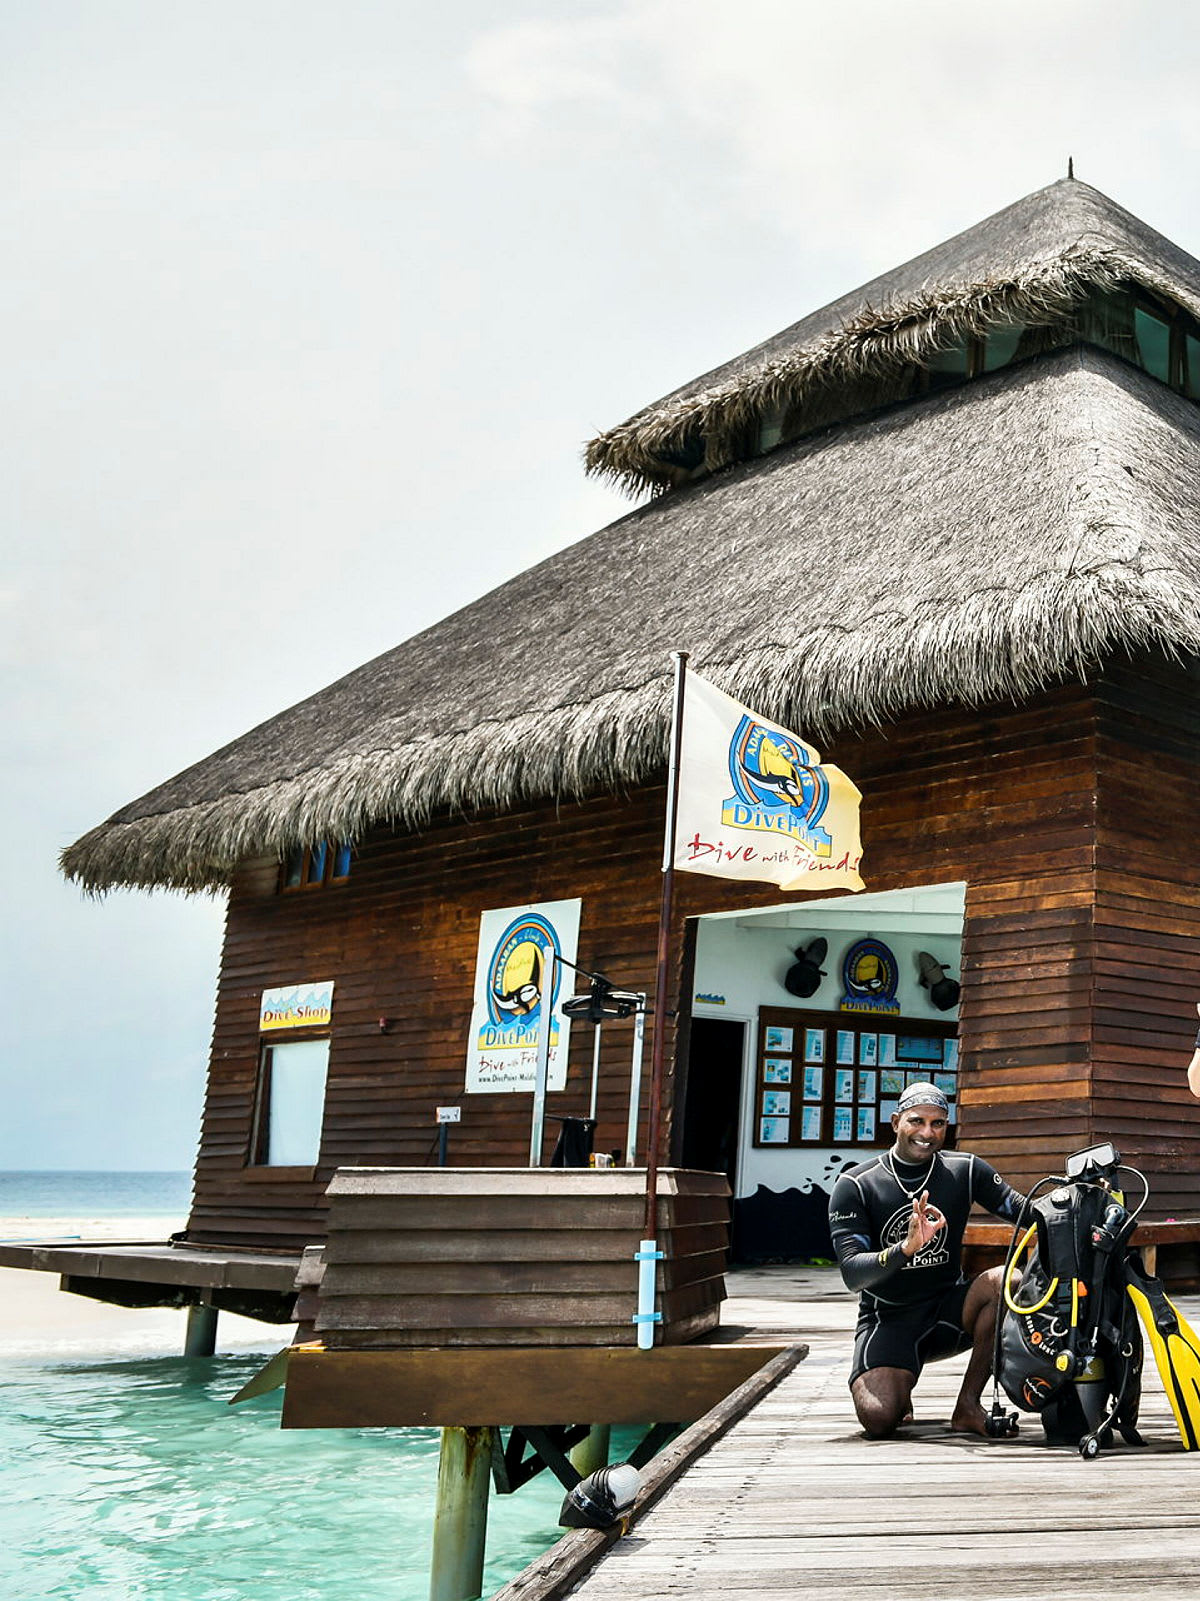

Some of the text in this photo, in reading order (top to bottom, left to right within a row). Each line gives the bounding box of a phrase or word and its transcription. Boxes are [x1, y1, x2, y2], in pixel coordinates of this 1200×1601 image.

[687, 832, 758, 863] Dive
[762, 850, 790, 863] with
[264, 1006, 328, 1022] Dive Shop
[478, 1056, 505, 1073] Dive
